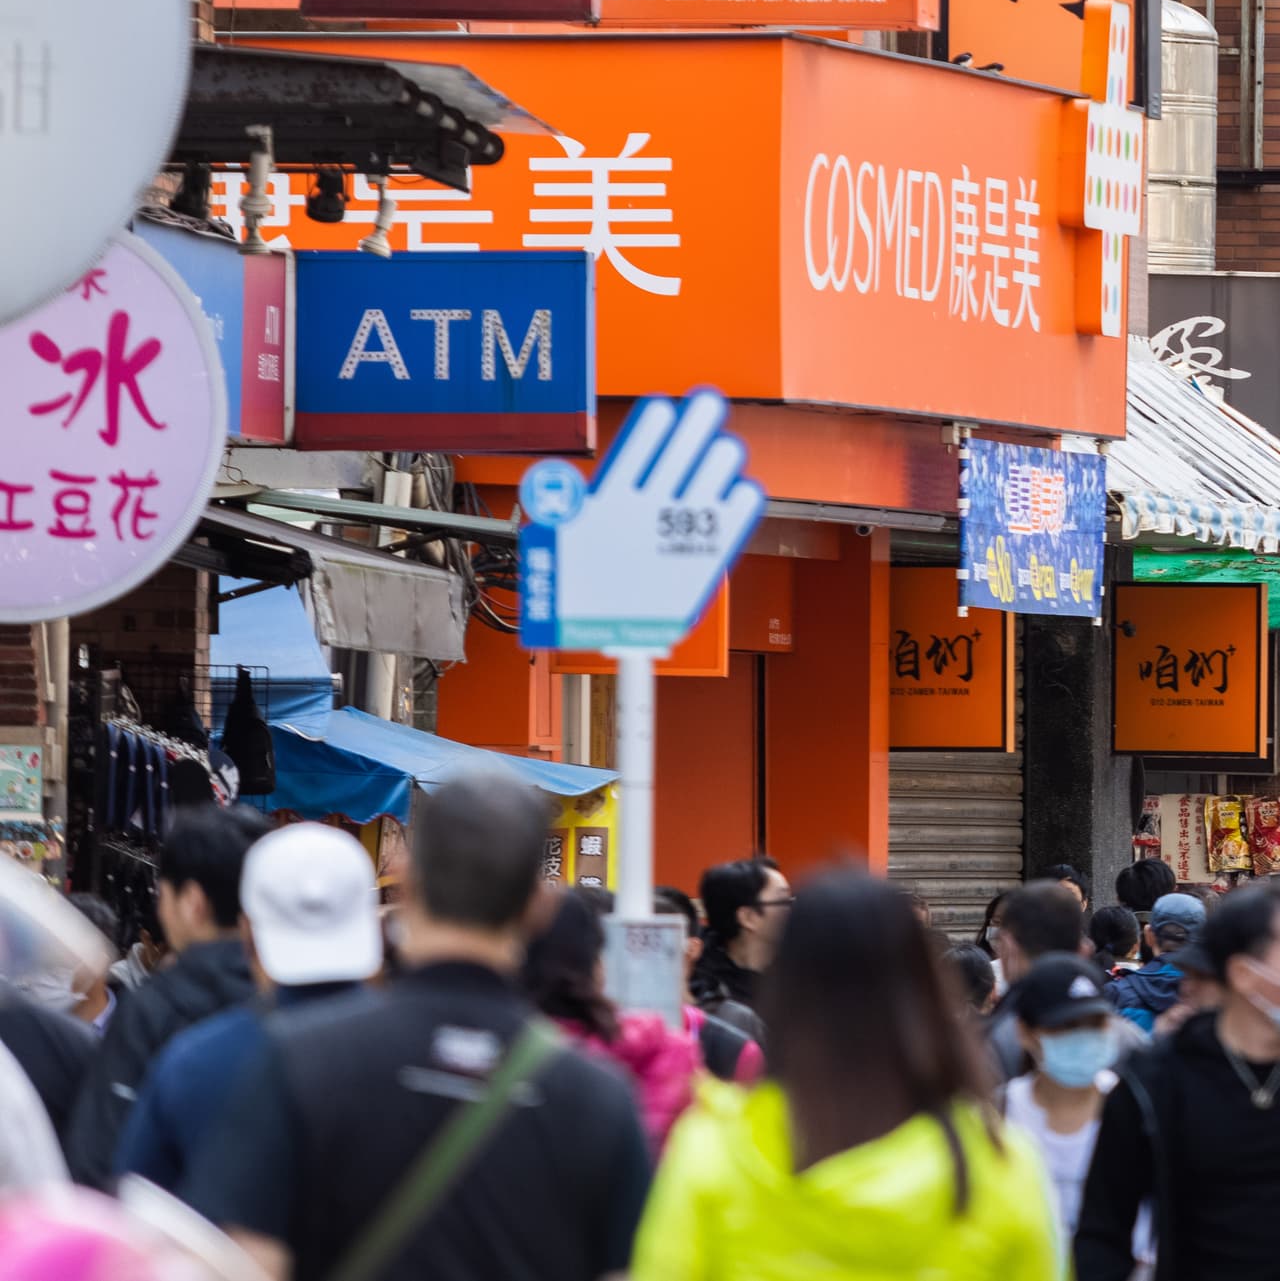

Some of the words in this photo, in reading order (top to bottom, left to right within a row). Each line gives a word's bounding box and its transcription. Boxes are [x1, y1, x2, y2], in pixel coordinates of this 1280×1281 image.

[803, 152, 946, 302] COSMED
[950, 162, 1041, 333] 康是美
[28, 310, 168, 447] 冰
[337, 309, 553, 381] ATM
